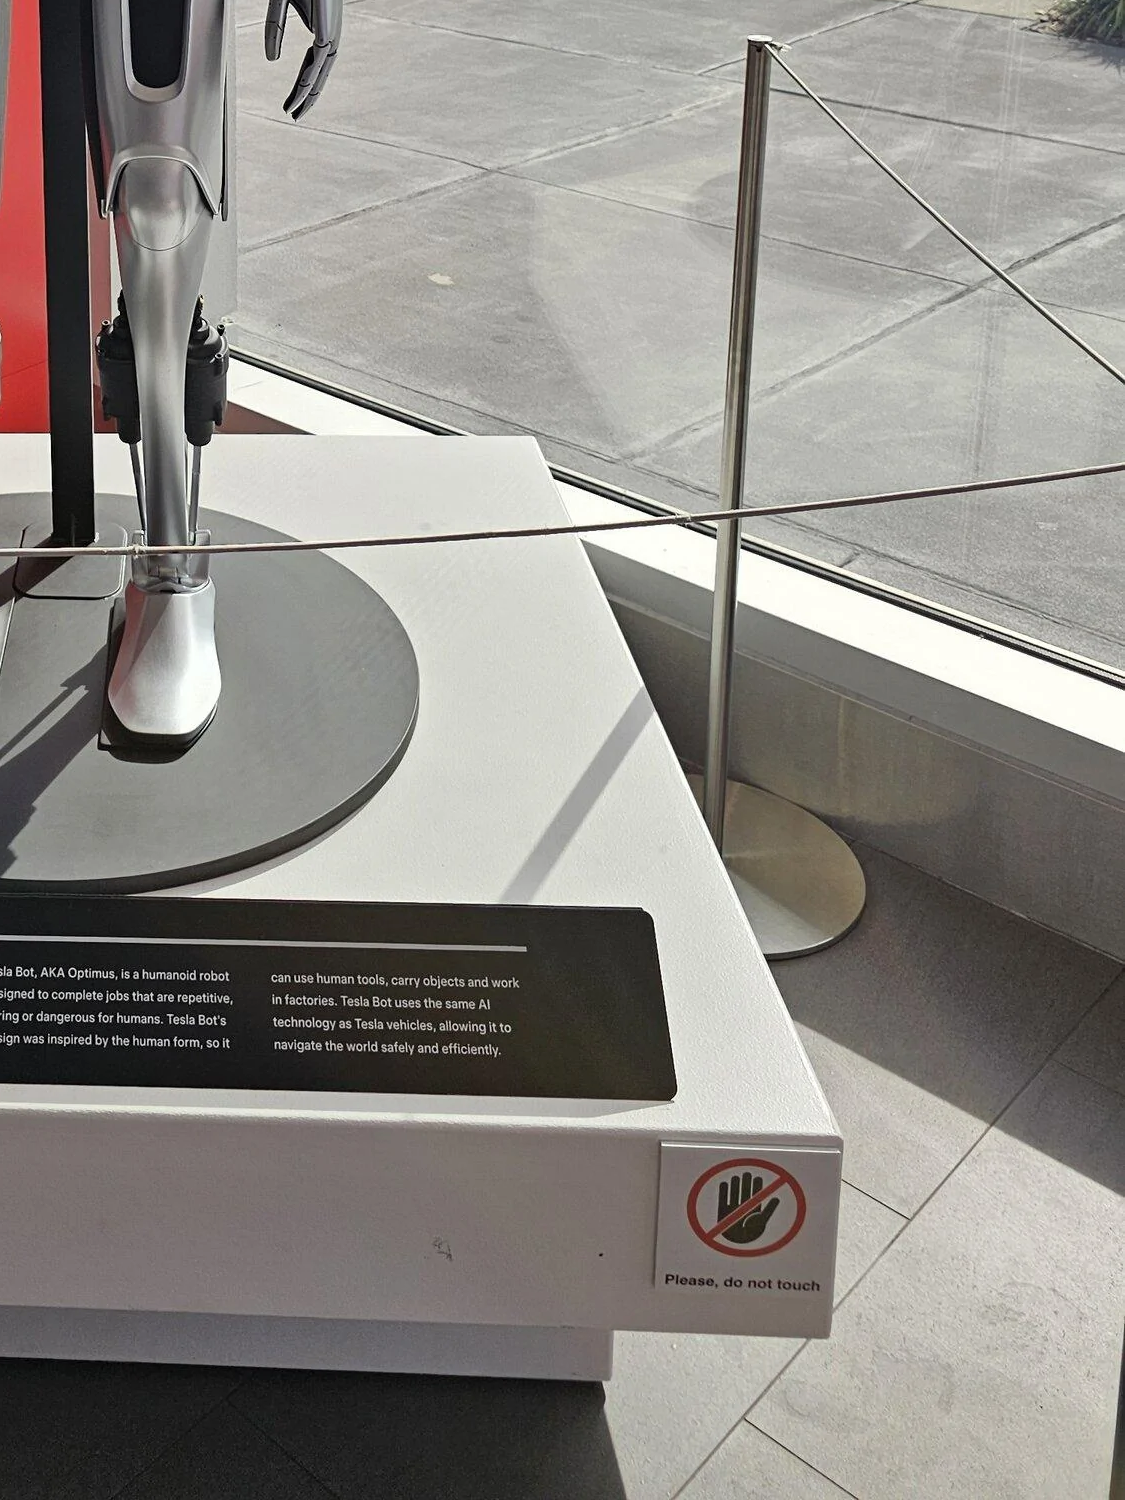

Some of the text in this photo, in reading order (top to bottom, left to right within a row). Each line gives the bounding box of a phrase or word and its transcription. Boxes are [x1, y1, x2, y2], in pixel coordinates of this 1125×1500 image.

[15, 966, 38, 979] Bot,
[40, 966, 66, 978] AKA
[67, 966, 119, 981] Optimus,
[120, 968, 131, 980] is
[132, 970, 140, 980] a
[141, 968, 197, 981] humanoid
[199, 970, 230, 982] robot
[270, 972, 520, 990] can use human tools, carry objects and work
[37, 989, 49, 1000] to
[51, 989, 104, 1003] complete
[105, 989, 130, 1004] jobs
[131, 990, 155, 1002] that
[156, 993, 175, 1003] are
[177, 992, 234, 1006] repetitive,
[271, 993, 491, 1010] in factories. Tesla Bot uses the same AI
[21, 1012, 34, 1022] or
[35, 1010, 96, 1025] dangerous
[97, 1011, 115, 1024] for
[116, 1012, 164, 1025] humans.
[166, 1013, 196, 1026] Tesla
[198, 1014, 227, 1027] Bot's
[272, 1016, 512, 1036] technology as Tesla vehicles, allowing it to
[22, 1035, 45, 1045] was
[47, 1033, 93, 1047] inspired
[94, 1034, 109, 1049] by
[111, 1034, 130, 1047] the
[132, 1034, 171, 1047] human
[172, 1035, 203, 1050] form,
[205, 1039, 220, 1049] so
[222, 1037, 231, 1049] it
[273, 1039, 502, 1058] navigate the world safely and efficiently.
[664, 1273, 821, 1292] Please, do not touch
